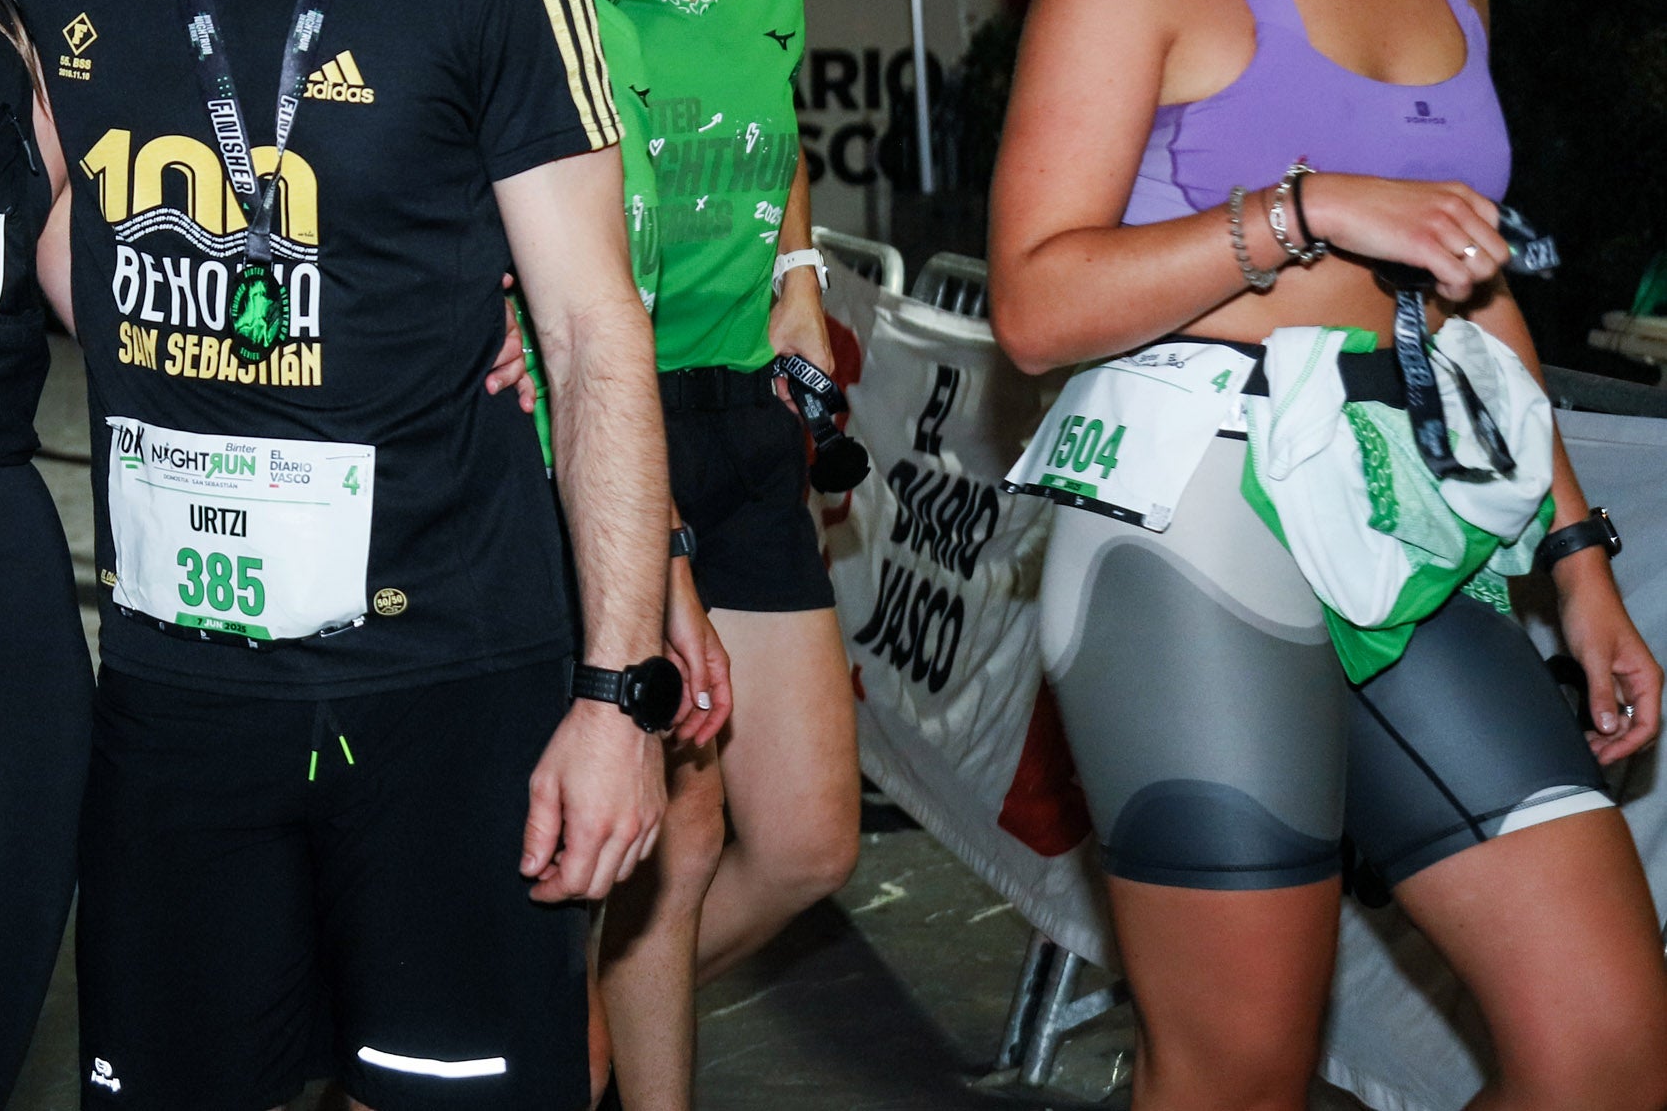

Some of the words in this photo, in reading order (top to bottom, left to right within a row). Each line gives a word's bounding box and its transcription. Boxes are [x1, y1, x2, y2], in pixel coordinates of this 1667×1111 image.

[793, 47, 943, 111] RIO
[207, 99, 255, 194] FINISHER
[79, 128, 320, 246] 100
[112, 245, 322, 338] BEHOA
[118, 321, 158, 371] SAN
[783, 355, 832, 393] FINISH
[1210, 368, 1232, 393] 4
[116, 424, 146, 465] 10K
[225, 442, 257, 454] Binter
[270, 449, 285, 460] EL
[1047, 414, 1127, 480] 1504
[270, 460, 313, 473] DIARIO
[270, 472, 311, 484] VASCO
[342, 465, 360, 496] 4
[189, 503, 247, 538] URTZI
[176, 546, 266, 617] 385
[197, 617, 203, 626] 7
[204, 618, 223, 629] JUN
[224, 622, 247, 633] 2025
[853, 558, 965, 694] VASCO
